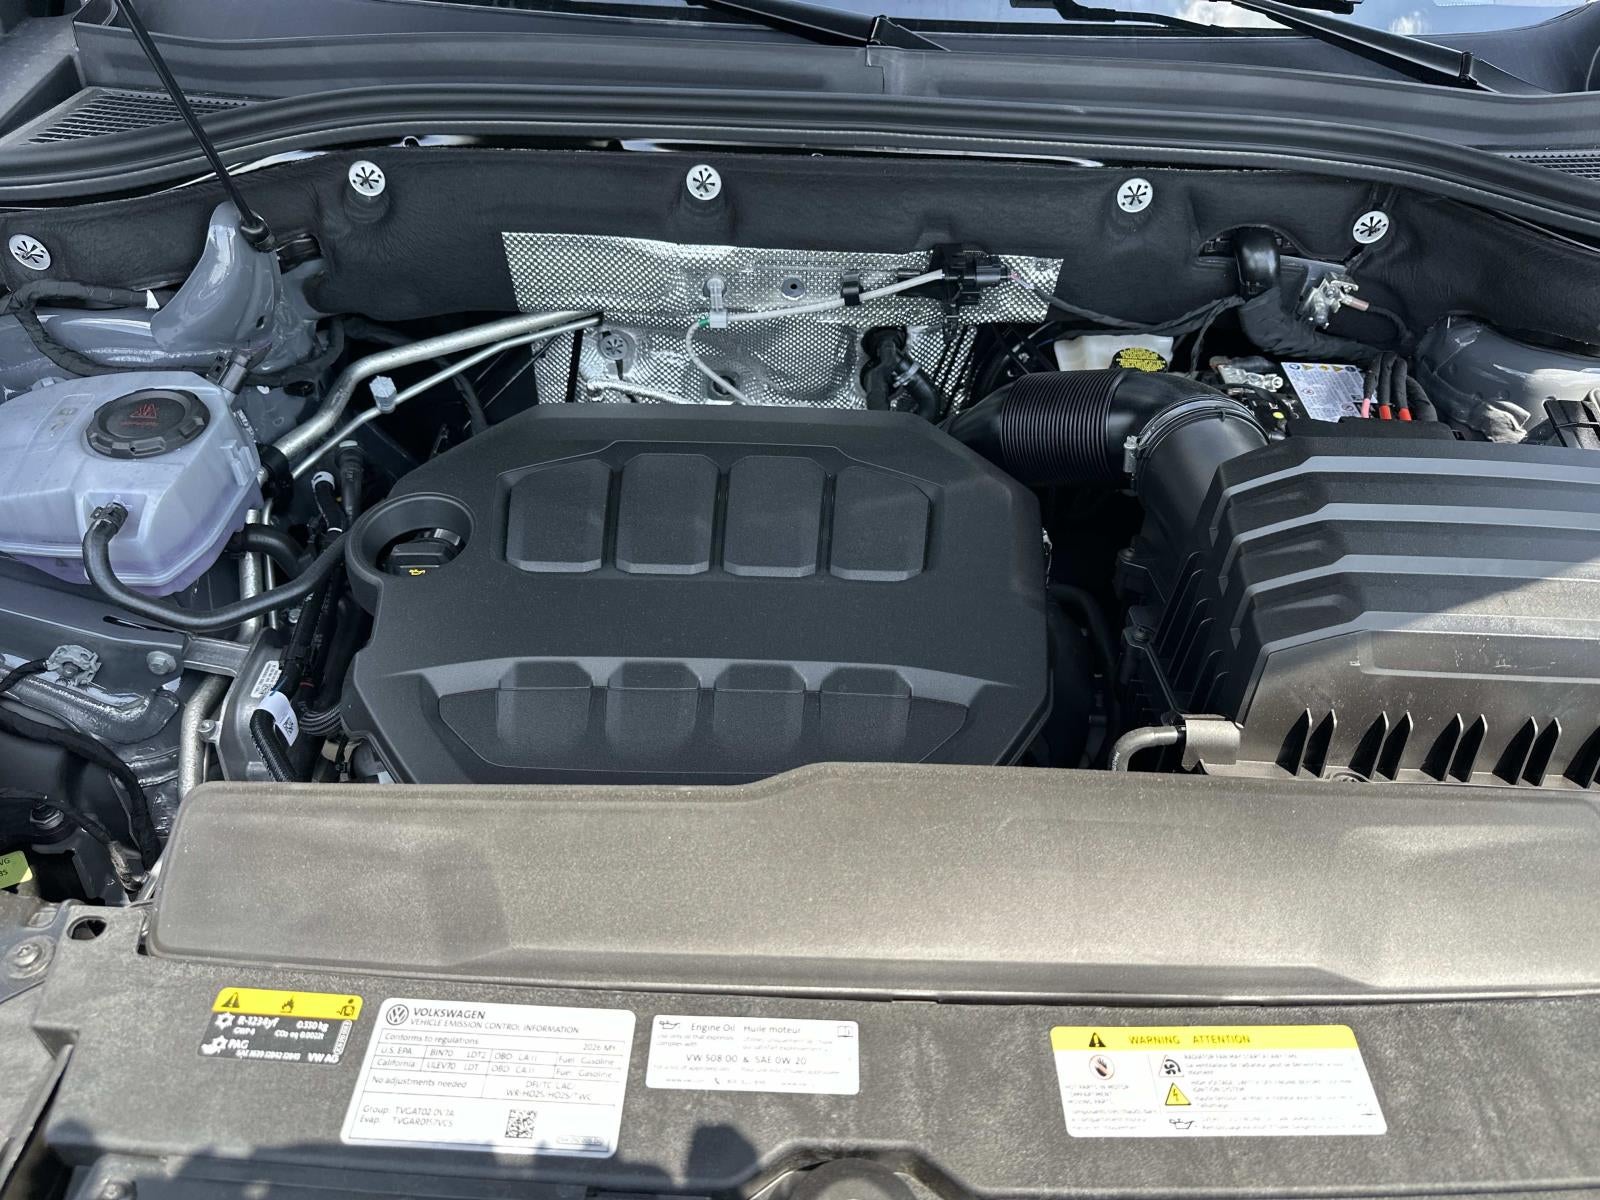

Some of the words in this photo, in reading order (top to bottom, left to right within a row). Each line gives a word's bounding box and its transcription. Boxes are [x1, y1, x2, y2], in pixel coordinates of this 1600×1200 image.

[413, 1007, 485, 1019] VOLKSWAGEN
[236, 1015, 280, 1030] R-1234yf
[318, 1021, 329, 1032] kg
[411, 1019, 441, 1027] VEHICLE
[443, 1020, 482, 1029] EMISSION
[485, 1022, 520, 1032] CONTROL
[523, 1024, 579, 1034] INFORMATION
[691, 1023, 721, 1034] Engine
[723, 1024, 736, 1032] Oil
[769, 1026, 801, 1034] moteur
[385, 1032, 423, 1041] Conforms
[425, 1034, 432, 1042] to
[434, 1035, 480, 1046] regulations
[1129, 1034, 1181, 1045] WARNING
[1193, 1034, 1250, 1045] ATTENTION
[227, 1039, 249, 1050] PAG
[397, 1047, 412, 1055] EPA
[430, 1048, 454, 1057] BIN70
[307, 1053, 323, 1063] VW
[494, 1052, 513, 1061] OBD
[580, 1057, 614, 1066] Gasoline
[686, 1054, 703, 1062] VW
[705, 1054, 722, 1063] 508
[725, 1054, 738, 1063] 00
[755, 1056, 772, 1064] SAE
[377, 1059, 415, 1068] California
[491, 1065, 510, 1073] OBD
[372, 1076, 383, 1084] No
[384, 1076, 435, 1088] adjustments
[437, 1080, 467, 1088] needed
